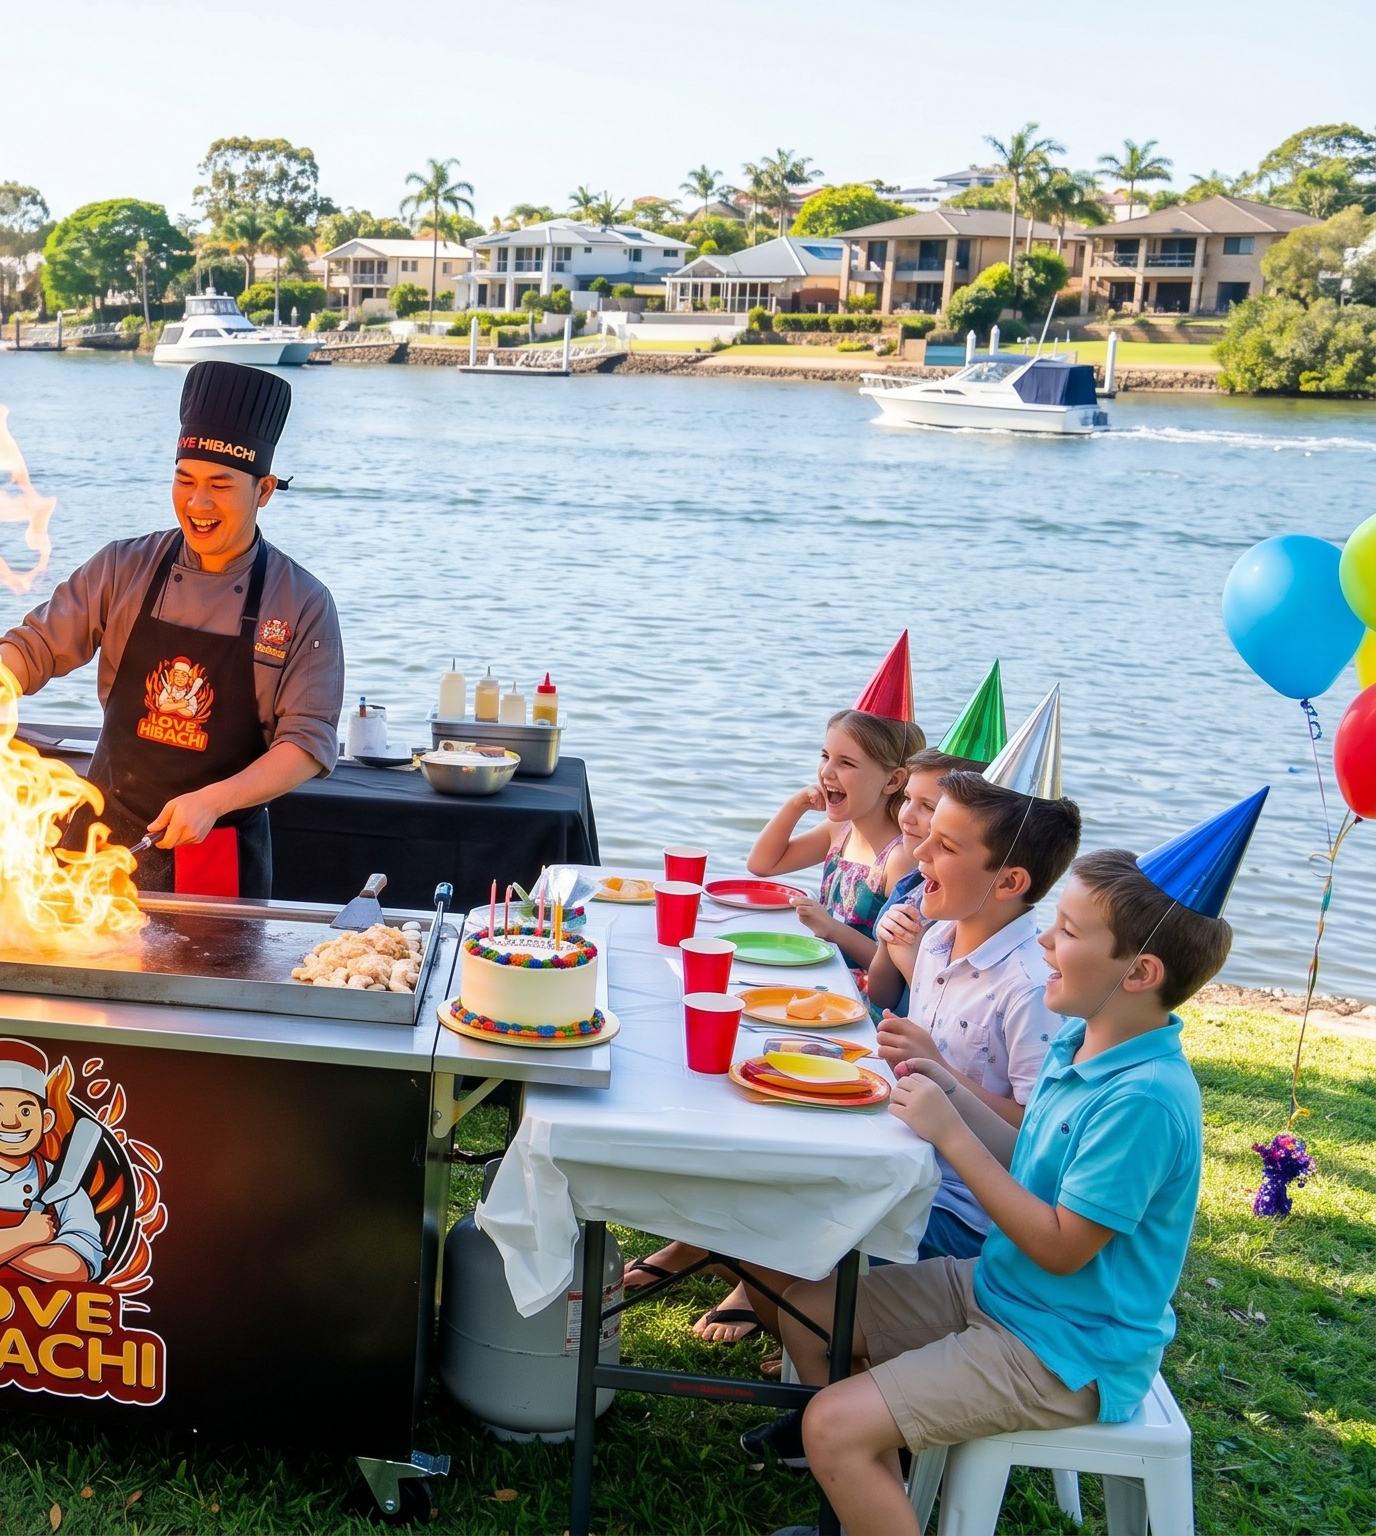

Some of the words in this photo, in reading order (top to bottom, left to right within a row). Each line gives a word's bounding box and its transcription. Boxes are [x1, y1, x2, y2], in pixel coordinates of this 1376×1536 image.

[177, 437, 197, 449] OVE
[197, 437, 256, 462] HIBACHI
[139, 721, 206, 749] HIBACHI
[151, 712, 197, 733] LOVE
